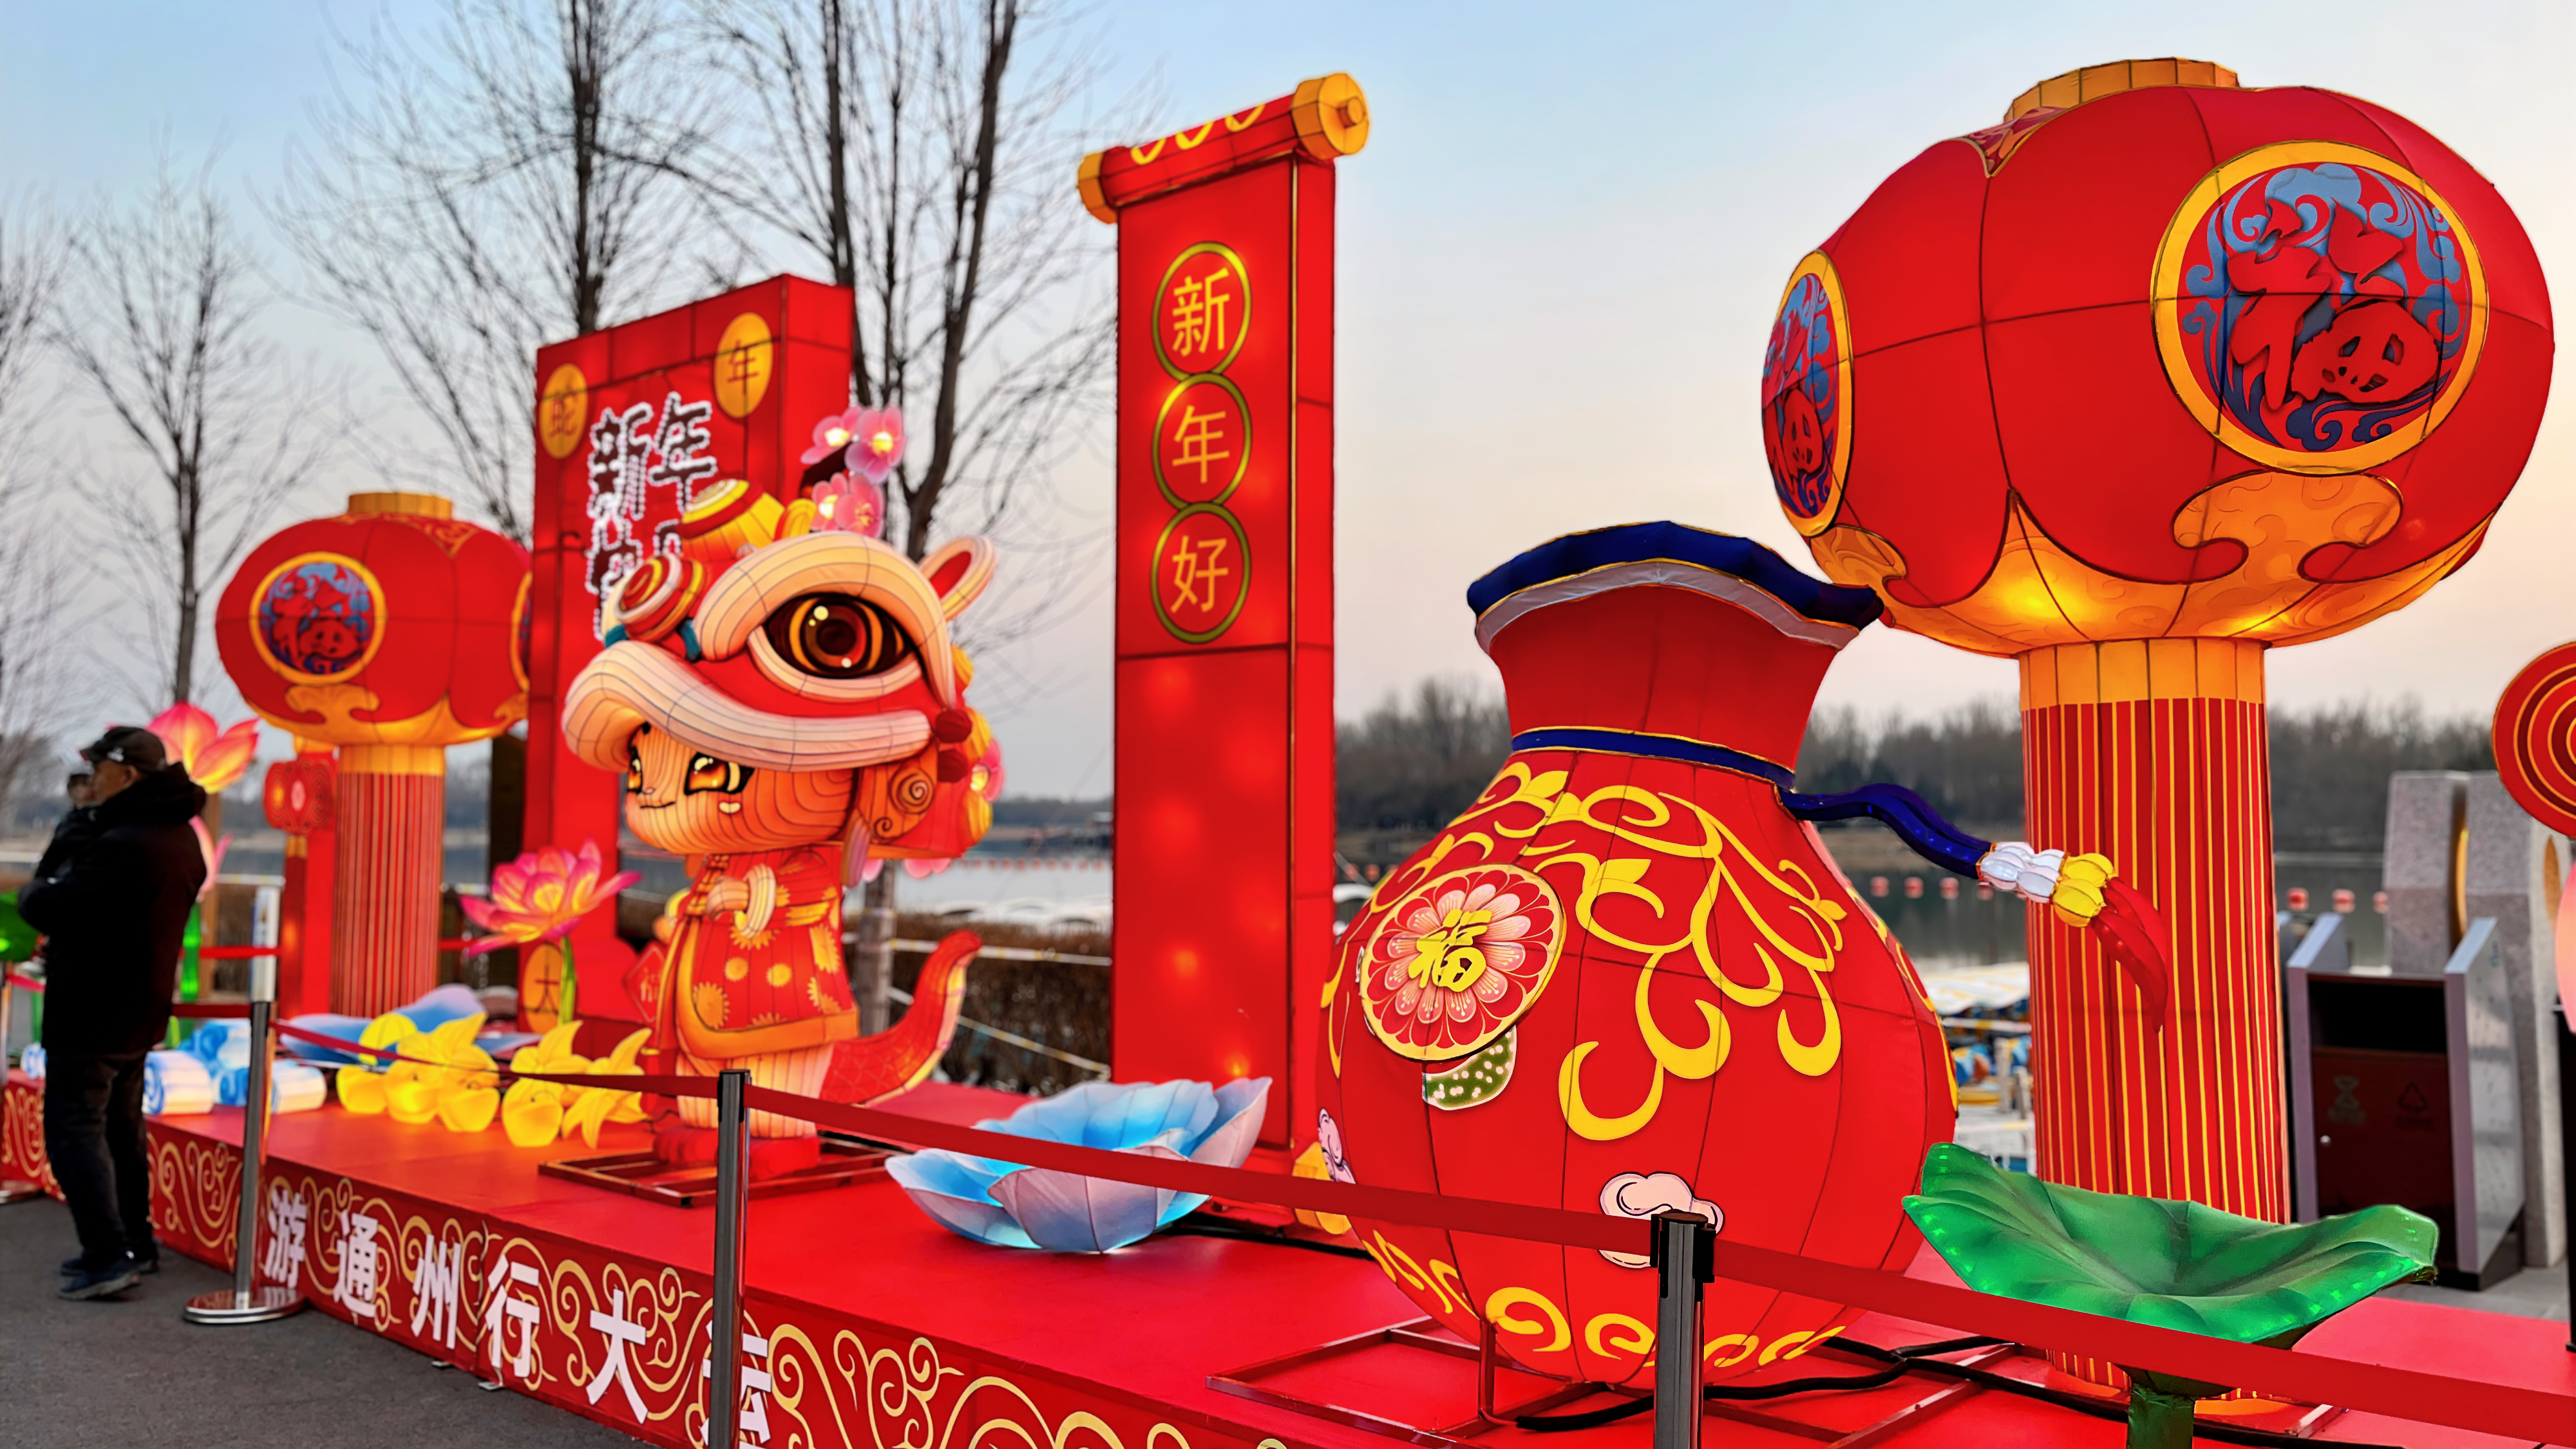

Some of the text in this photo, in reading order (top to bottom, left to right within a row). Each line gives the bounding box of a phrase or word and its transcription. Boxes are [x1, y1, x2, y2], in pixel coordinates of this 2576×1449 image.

[726, 339, 760, 395] 年
[587, 392, 720, 520] 新年
[1171, 267, 1230, 613] 新年好
[1408, 909, 1492, 992] 福
